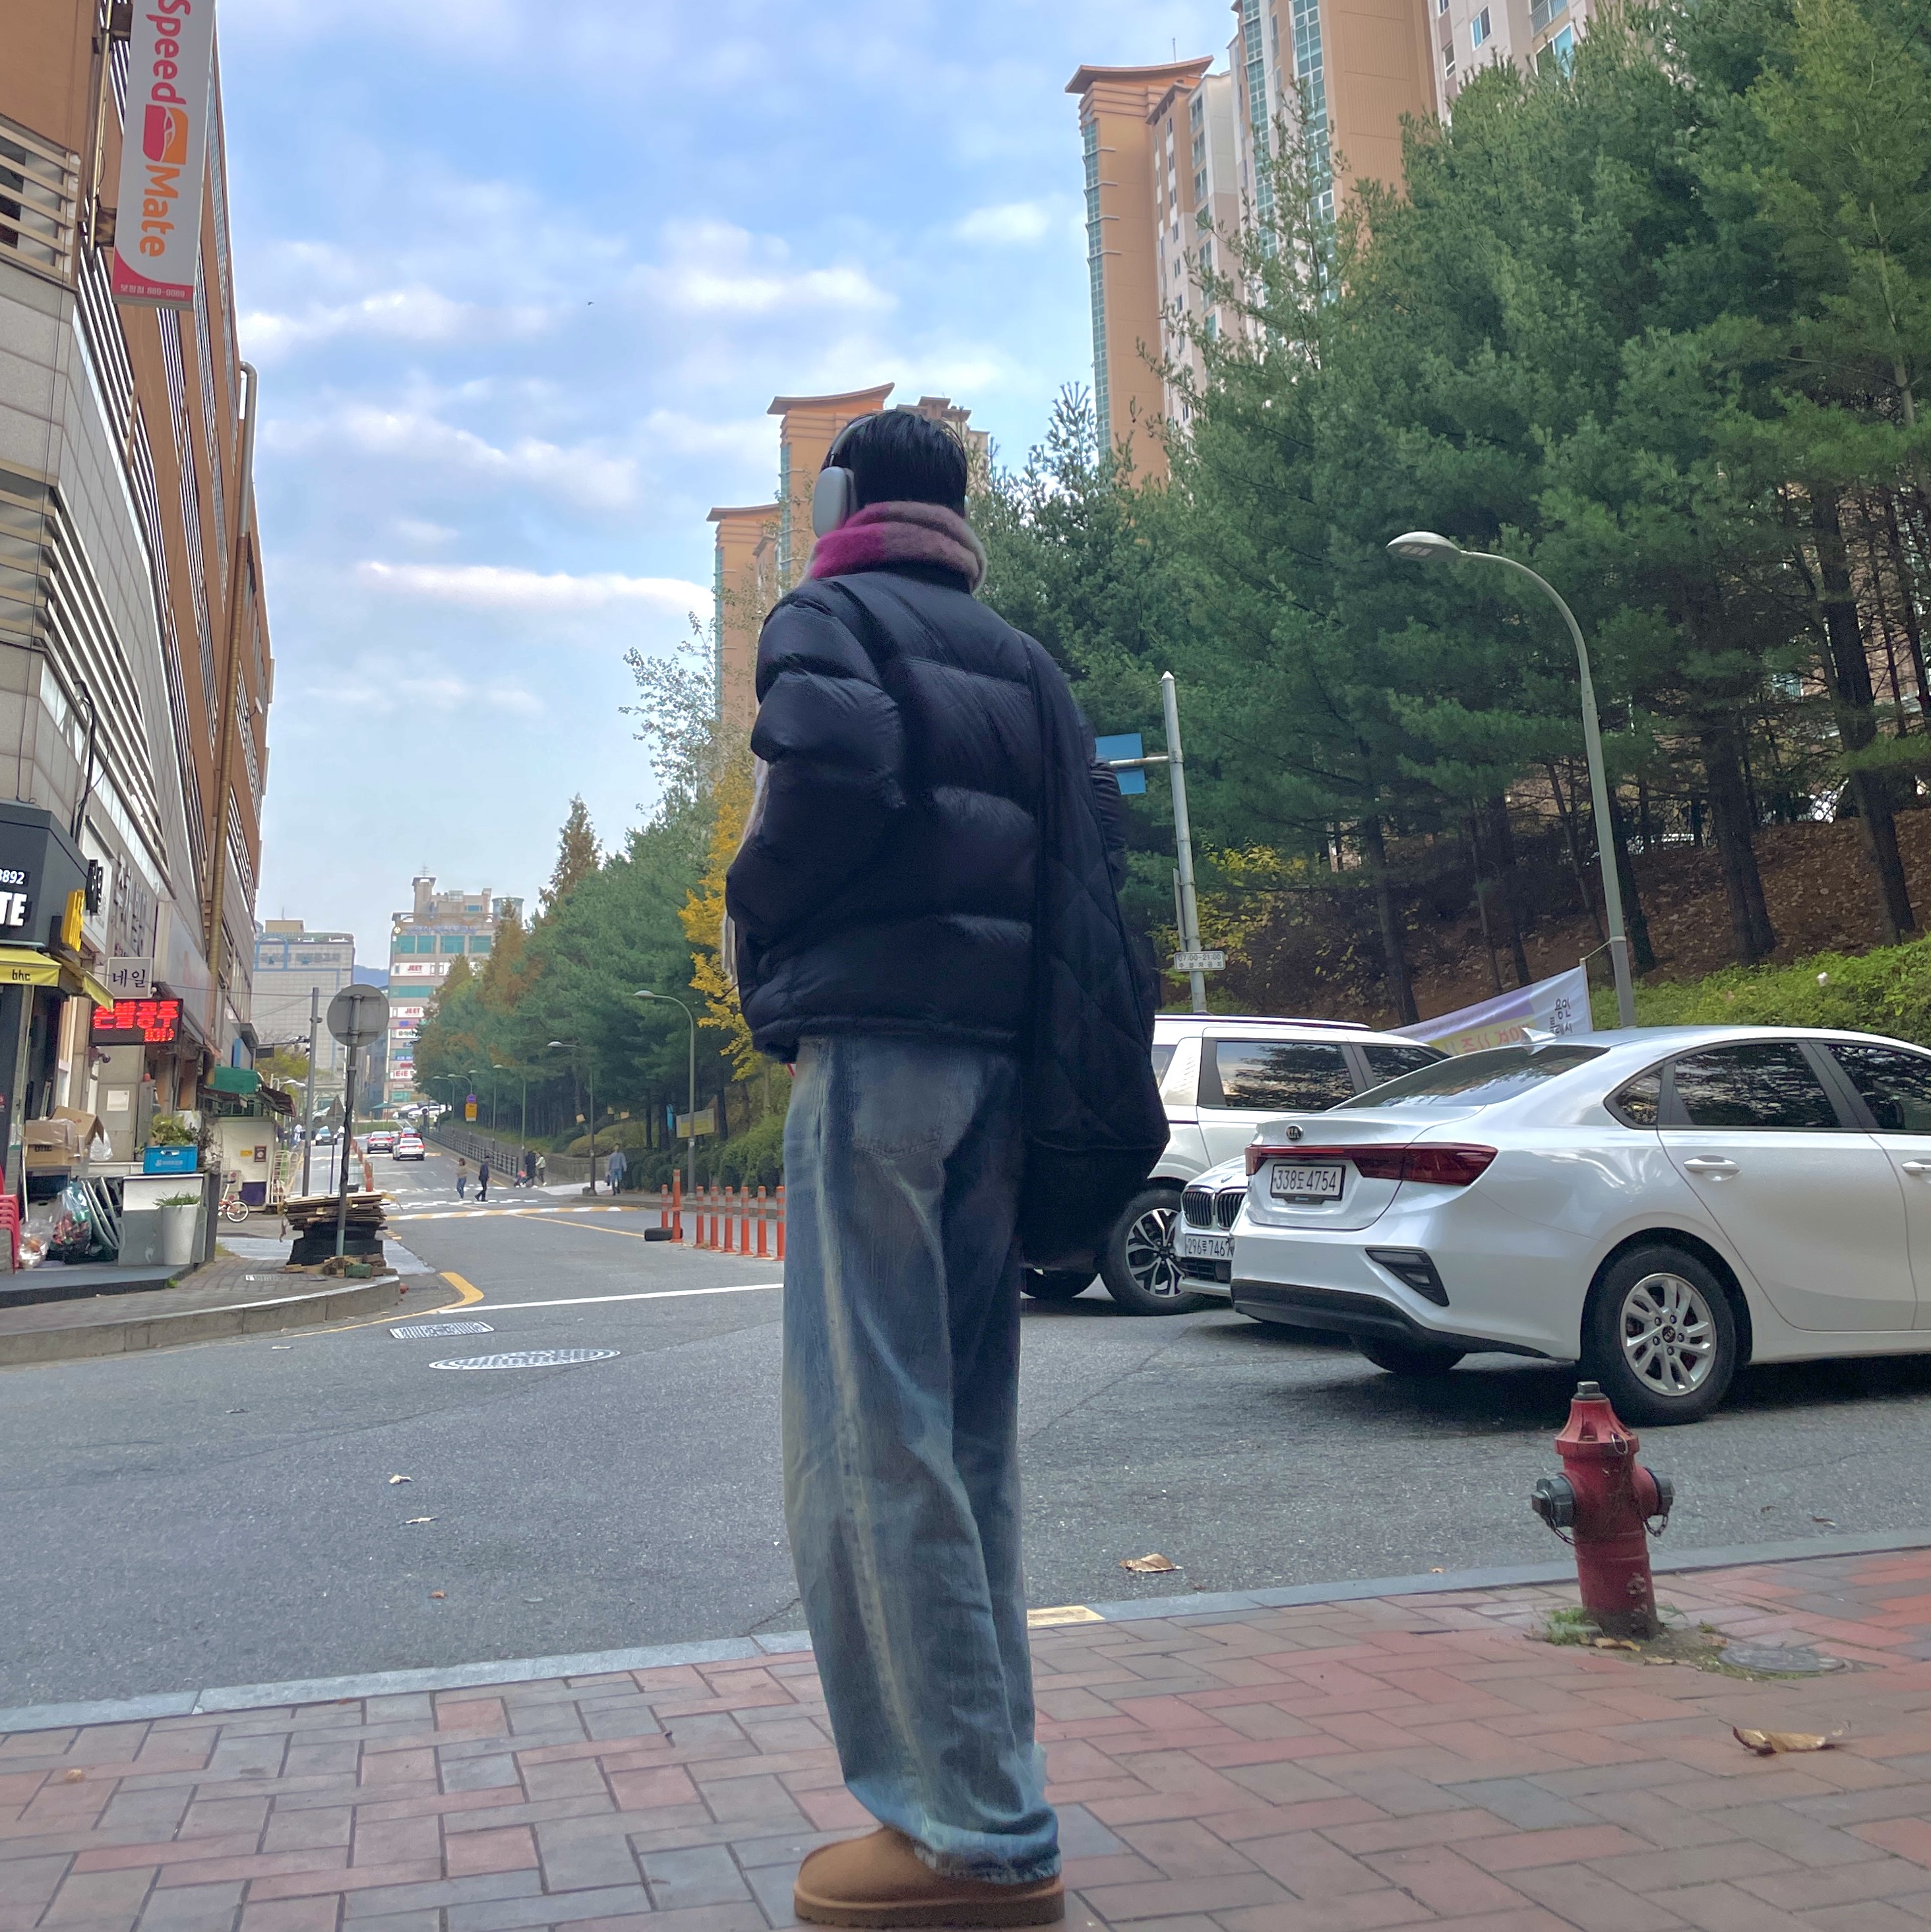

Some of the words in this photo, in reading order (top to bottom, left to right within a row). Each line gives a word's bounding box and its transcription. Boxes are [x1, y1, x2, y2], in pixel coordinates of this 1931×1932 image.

[146, 0, 192, 104] Speed
[139, 164, 181, 257] Mate
[12, 969, 31, 981] bhc
[112, 969, 145, 988] 네일
